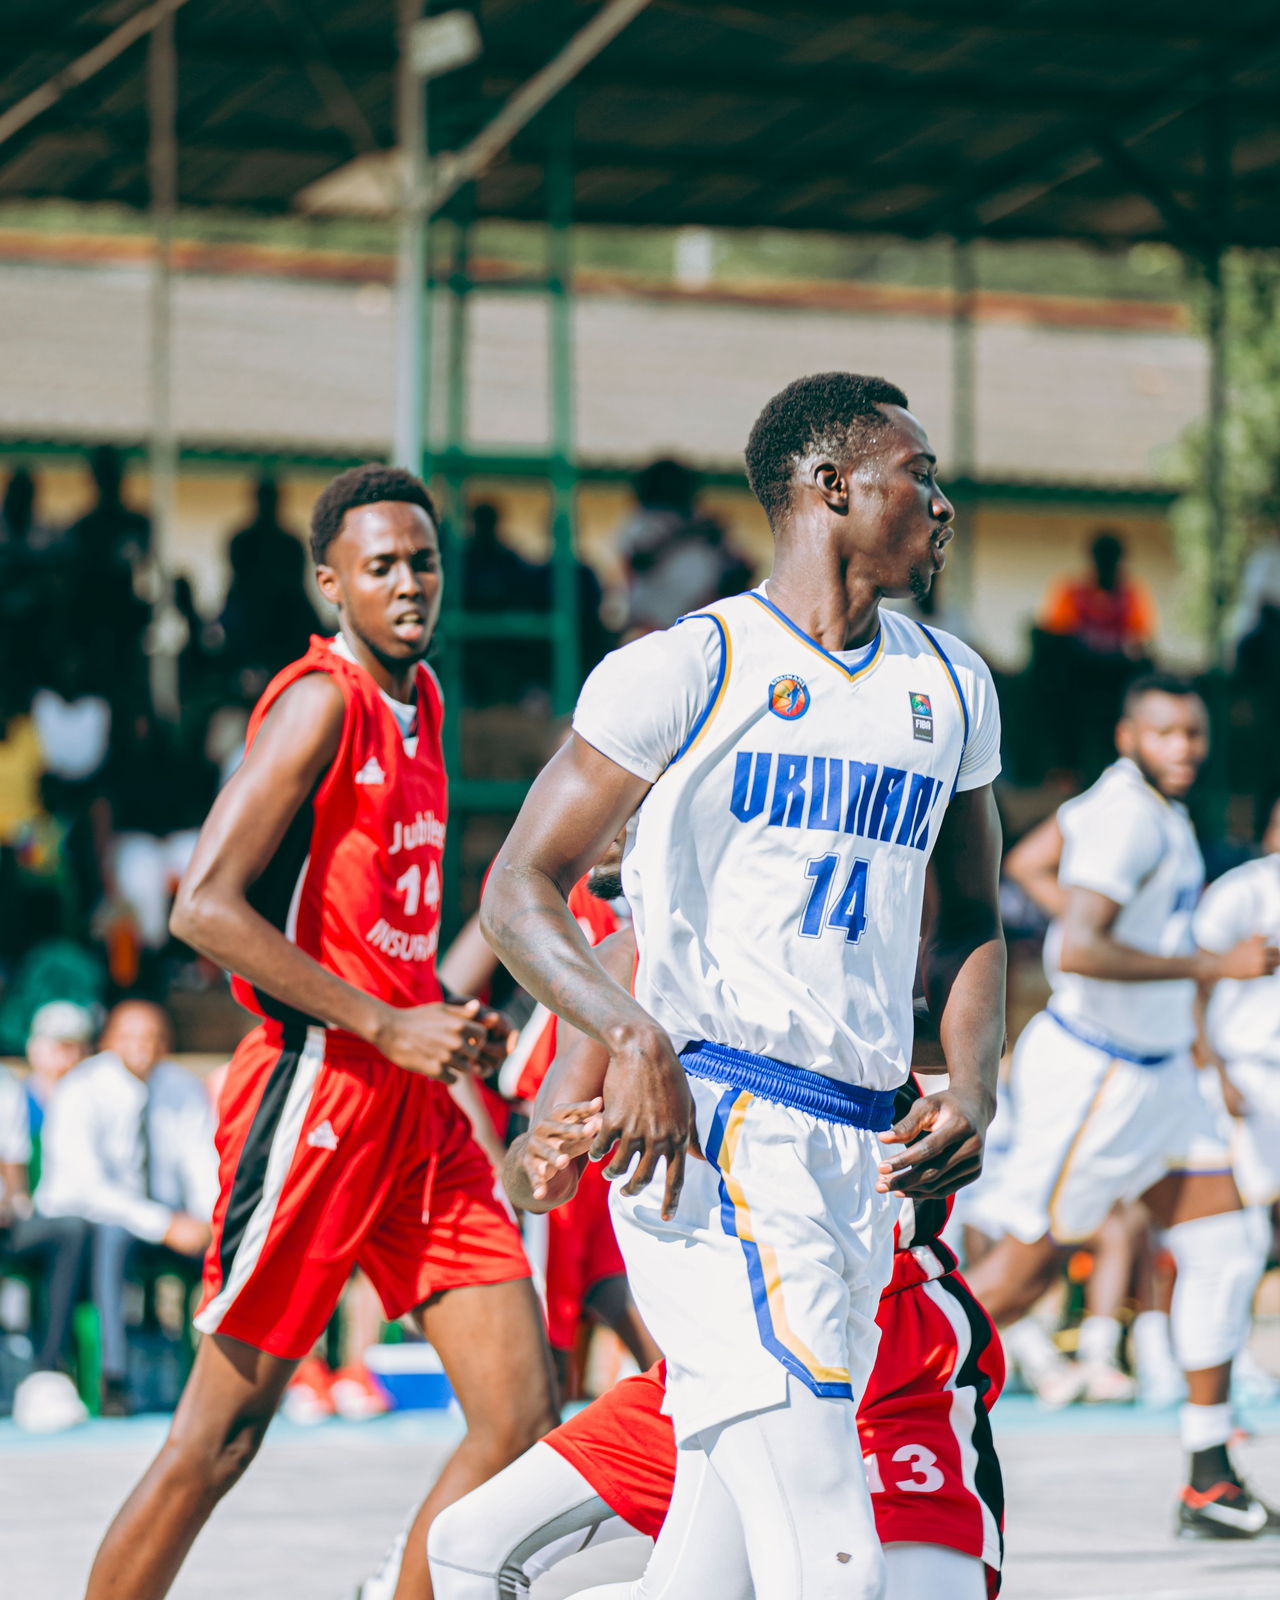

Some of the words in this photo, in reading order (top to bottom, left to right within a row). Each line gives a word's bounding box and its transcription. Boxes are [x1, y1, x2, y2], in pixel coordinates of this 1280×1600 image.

[915, 718, 931, 730] FIBA
[396, 860, 440, 916] 14
[798, 851, 871, 945] 14
